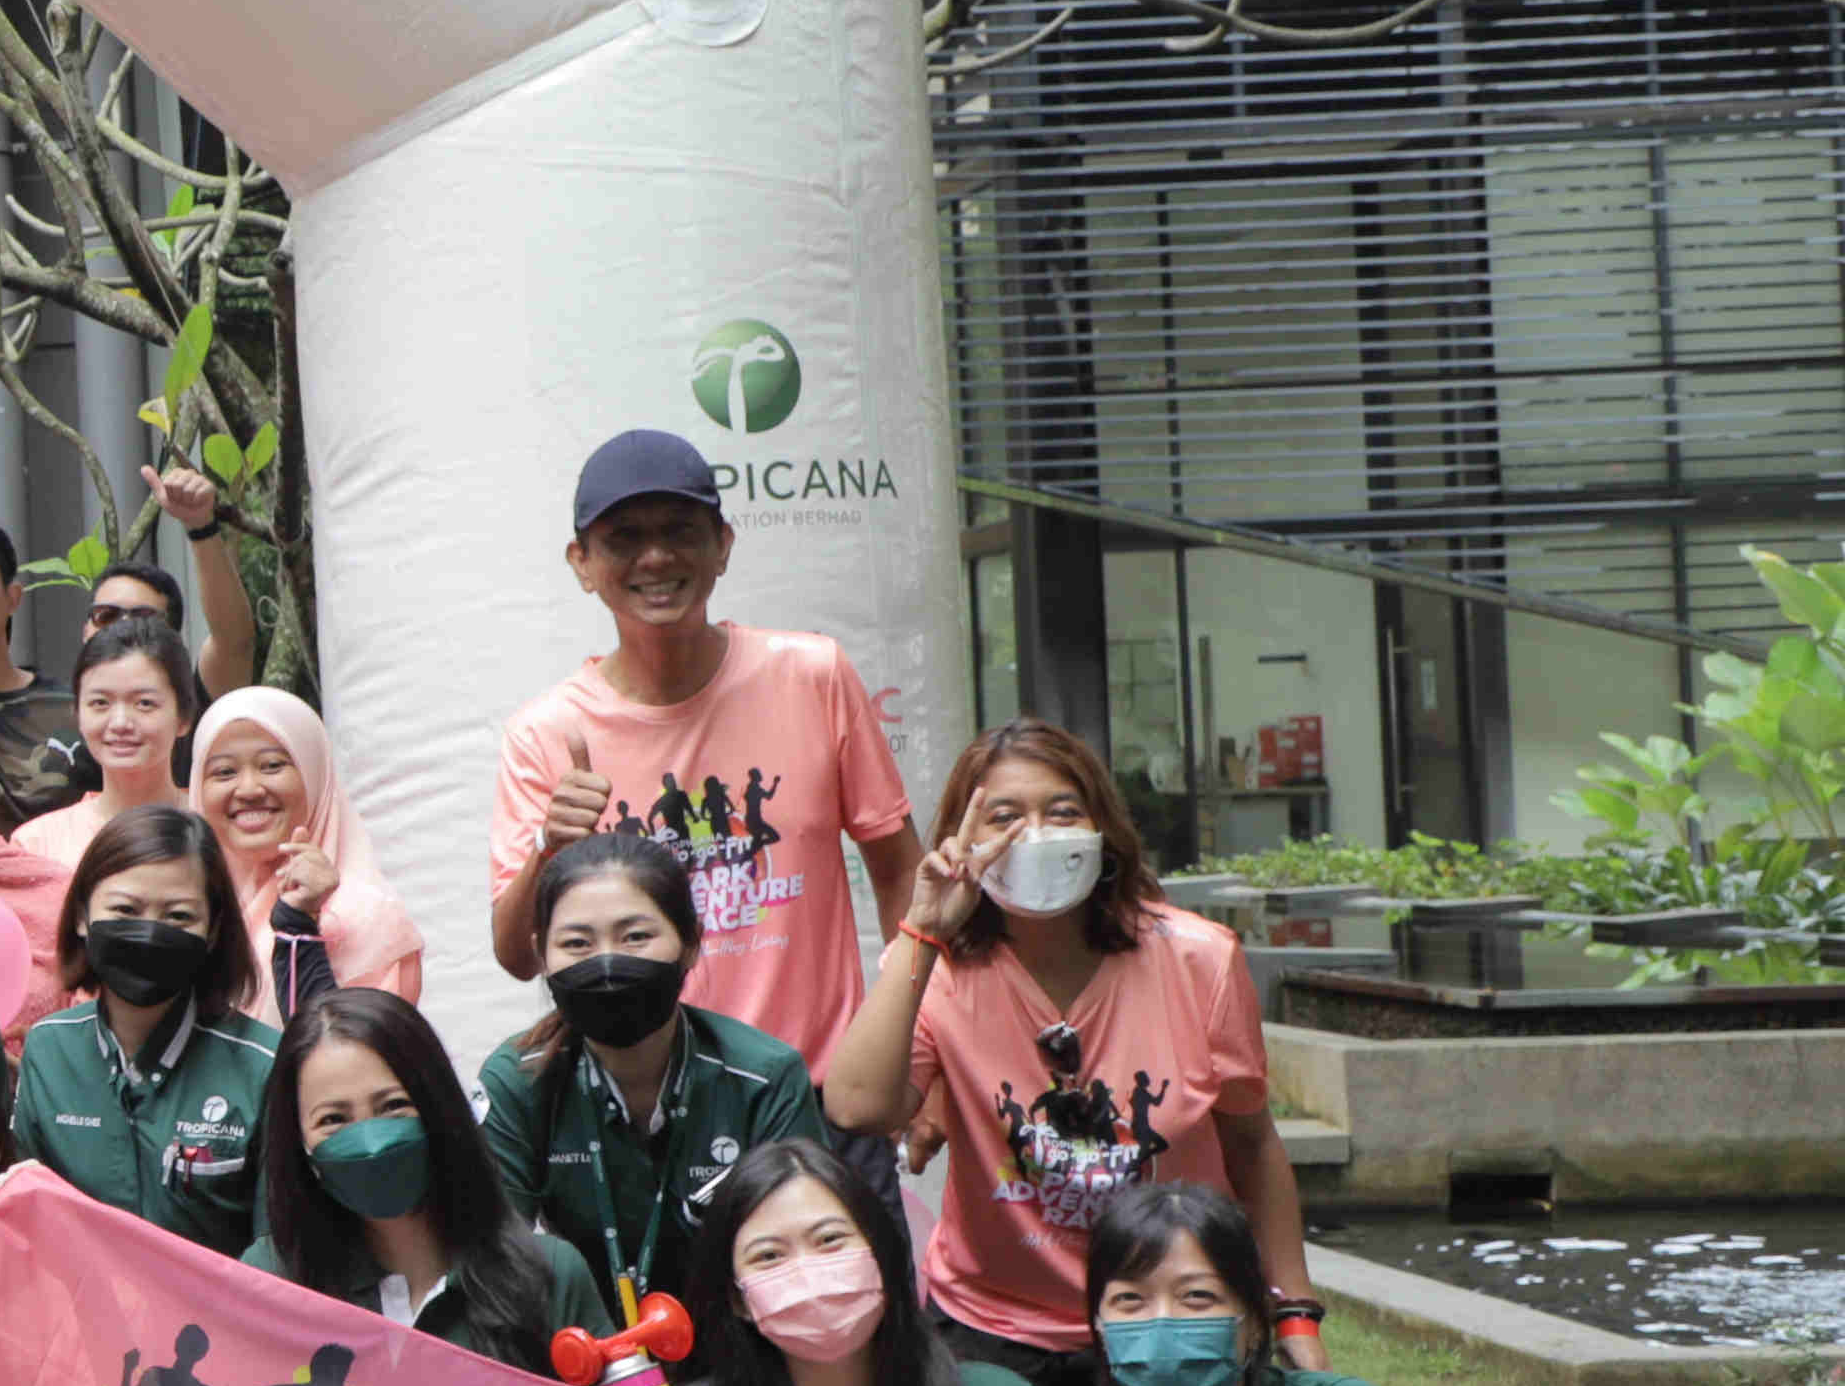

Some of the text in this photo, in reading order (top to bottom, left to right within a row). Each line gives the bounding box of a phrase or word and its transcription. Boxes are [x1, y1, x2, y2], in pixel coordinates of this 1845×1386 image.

[709, 458, 899, 503] PICANA
[793, 510, 863, 527] BERHAD
[689, 860, 755, 892] ARK
[691, 873, 806, 913] ENTURE
[702, 903, 760, 933] ACE
[175, 1120, 246, 1138] TROPICANA
